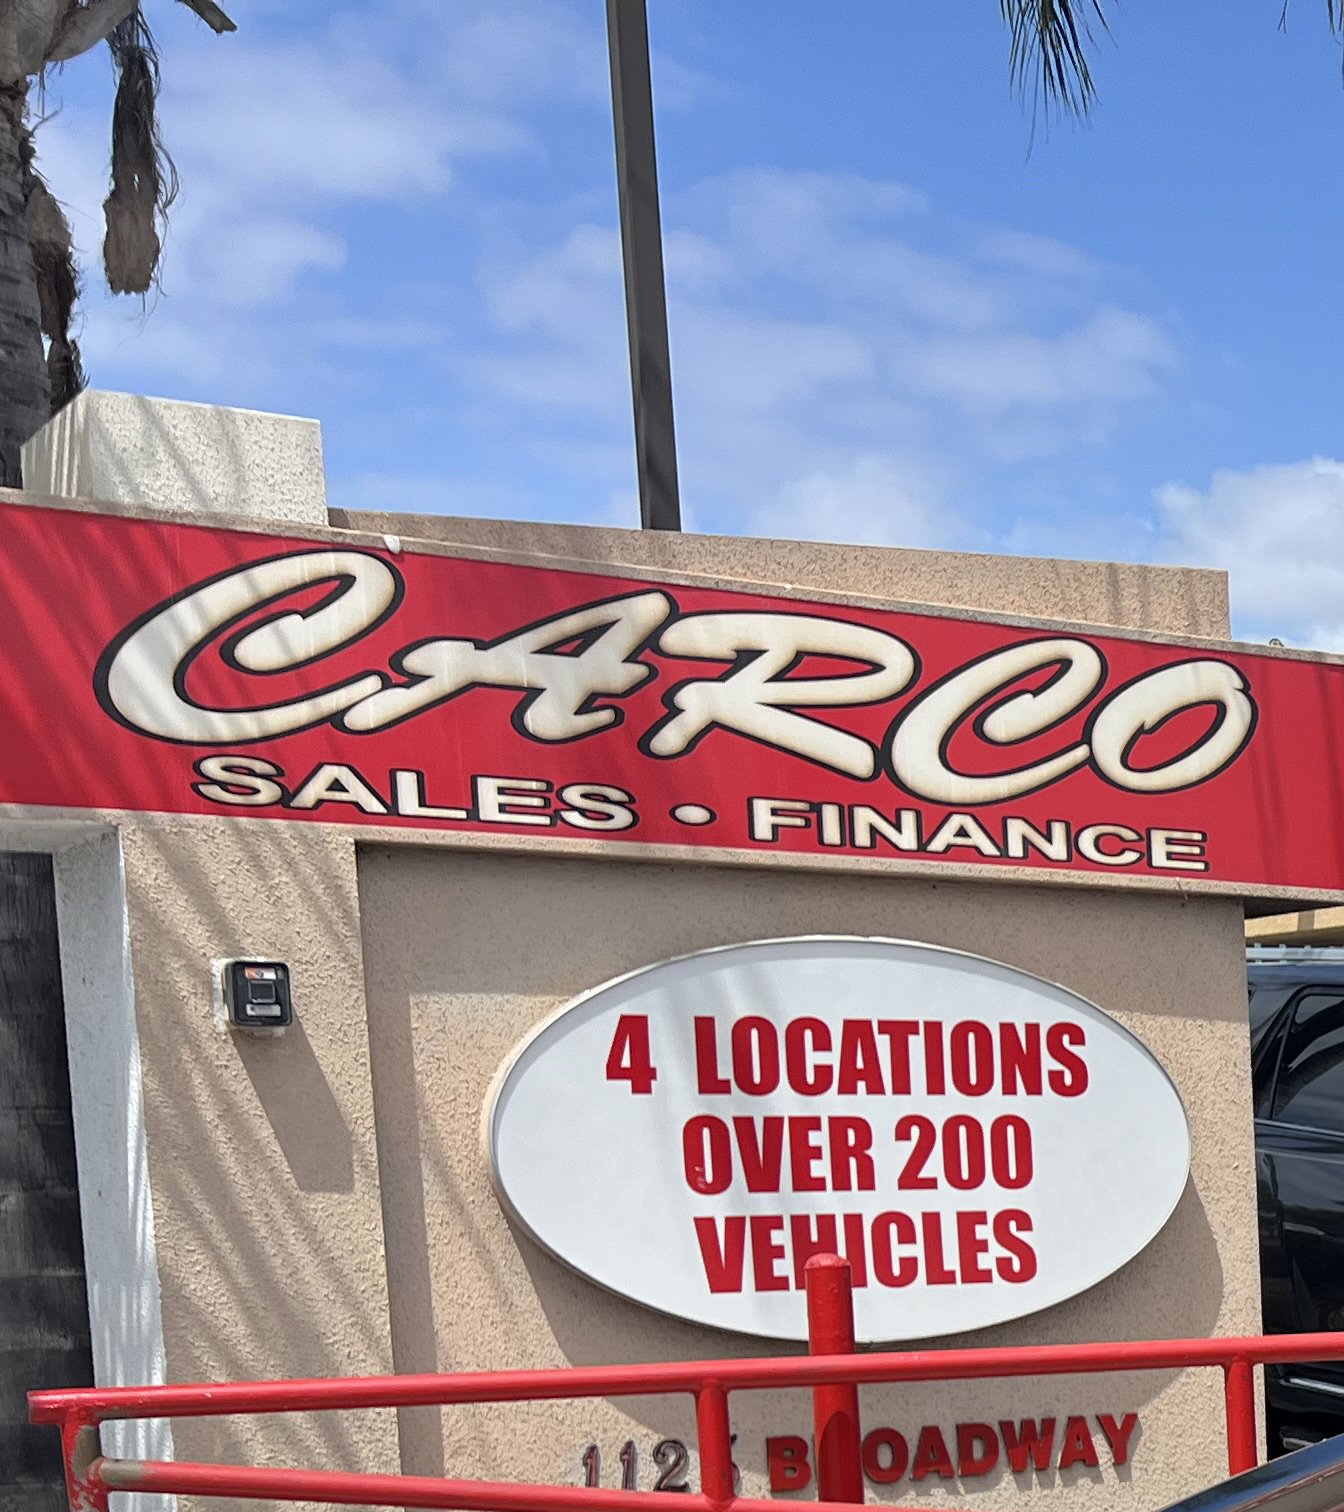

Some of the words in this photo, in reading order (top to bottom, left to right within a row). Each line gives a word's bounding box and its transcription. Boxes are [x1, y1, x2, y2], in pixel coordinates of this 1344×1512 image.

[94, 548, 1257, 806] CARCO
[192, 755, 639, 831] SALES
[748, 796, 1211, 871] FINANCE
[606, 1014, 657, 1094] 4
[694, 1015, 1089, 1097] LOCATIONS
[683, 1115, 876, 1196] OVER
[895, 1114, 1034, 1190] 200
[694, 1209, 1038, 1294] VEHICLES
[580, 1433, 741, 1493] 112
[766, 1412, 1139, 1493] BOADWAY
